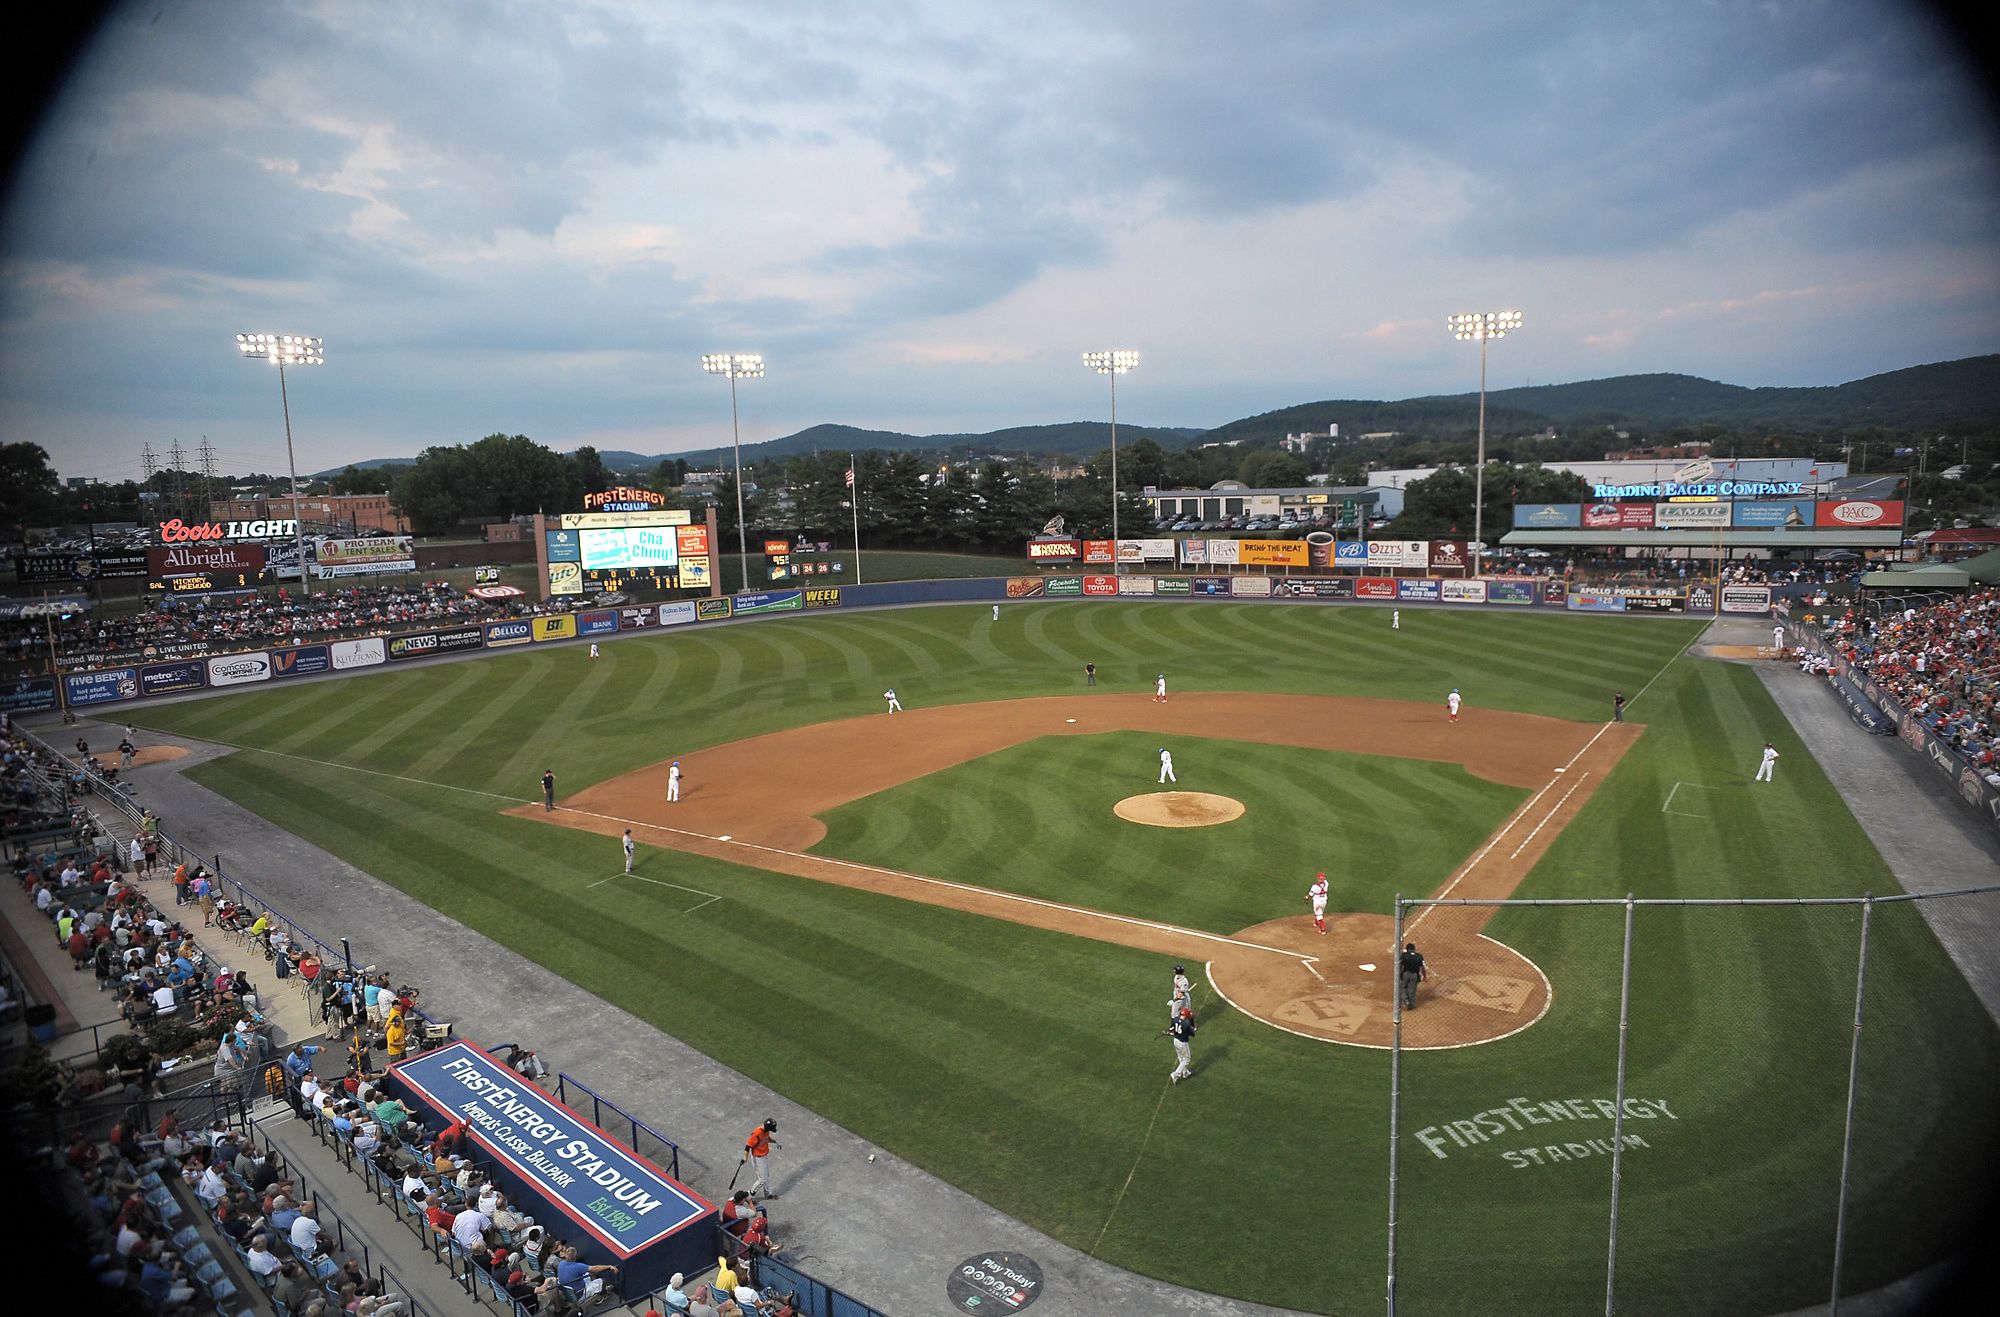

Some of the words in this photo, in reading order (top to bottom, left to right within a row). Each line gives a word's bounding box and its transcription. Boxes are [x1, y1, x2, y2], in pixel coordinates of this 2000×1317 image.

[1593, 484, 1660, 498] READING
[1664, 482, 1717, 496] EAGLE
[1720, 480, 1802, 496] COMPANY
[584, 486, 665, 510] FIRSTENERGY
[603, 502, 649, 512] STADIUM
[1664, 507, 1722, 516] LAMAR
[1841, 506, 1874, 519] RACC
[160, 517, 224, 543] Coors
[226, 519, 298, 539] LIGHT
[344, 540, 364, 548] PRO
[367, 538, 395, 546] TEAM
[639, 531, 663, 546] Cha
[345, 548, 367, 556] TENT
[370, 545, 396, 554] SALES
[632, 544, 673, 562] Ching!
[767, 544, 787, 552] xfinity
[1245, 544, 1266, 552] BRING
[1282, 544, 1302, 552] HEAT
[1369, 542, 1402, 554] OZZY'S
[23, 558, 66, 567] VALLEY
[101, 558, 122, 566] PRIDE
[163, 548, 237, 569] Albright
[772, 555, 785, 565] 95
[23, 565, 67, 574] FORGE
[791, 565, 798, 574] 9
[832, 563, 841, 571] 42
[475, 569, 499, 581] PUB
[590, 570, 598, 579] 12
[610, 570, 616, 578] 0
[172, 576, 207, 586] HICKORY
[173, 582, 212, 591] LAKEWOOD
[805, 589, 838, 601] WEEU
[1088, 585, 1114, 594] TOYOTA
[622, 608, 638, 617] White
[662, 606, 677, 615] Fulton
[678, 605, 691, 613] Bank
[592, 620, 612, 629] BANK
[438, 631, 480, 641] WFMZ.COM
[494, 625, 528, 636] BELLCO
[405, 635, 437, 650] NEWS
[439, 639, 468, 648] ALWAYS
[469, 636, 481, 644] ON
[159, 646, 177, 655] LIVE
[55, 655, 85, 666] United
[87, 653, 105, 663] Way
[335, 650, 382, 664] KUTZTOWN
[69, 675, 94, 687] five
[95, 672, 128, 683] BELOW
[144, 669, 188, 682] metroPCS
[90, 686, 107, 694] stuff.
[72, 694, 89, 702] cool
[89, 692, 113, 701] prices.
[1174, 1022, 1183, 1035] 16
[1414, 1097, 1678, 1160] FIRSTENERGY
[441, 1056, 568, 1146] FIRSTENERGY
[556, 1138, 662, 1216] STADIUM
[458, 1099, 502, 1137] AMERICA'S
[494, 1125, 531, 1157] CLASSIC
[524, 1149, 576, 1189] BALLPARK
[1500, 1134, 1650, 1169] STADIUM
[605, 1203, 637, 1233] 1950
[981, 1258, 1004, 1273] Play
[1003, 1268, 1036, 1289] Today!
[962, 1265, 1016, 1297] POWER
